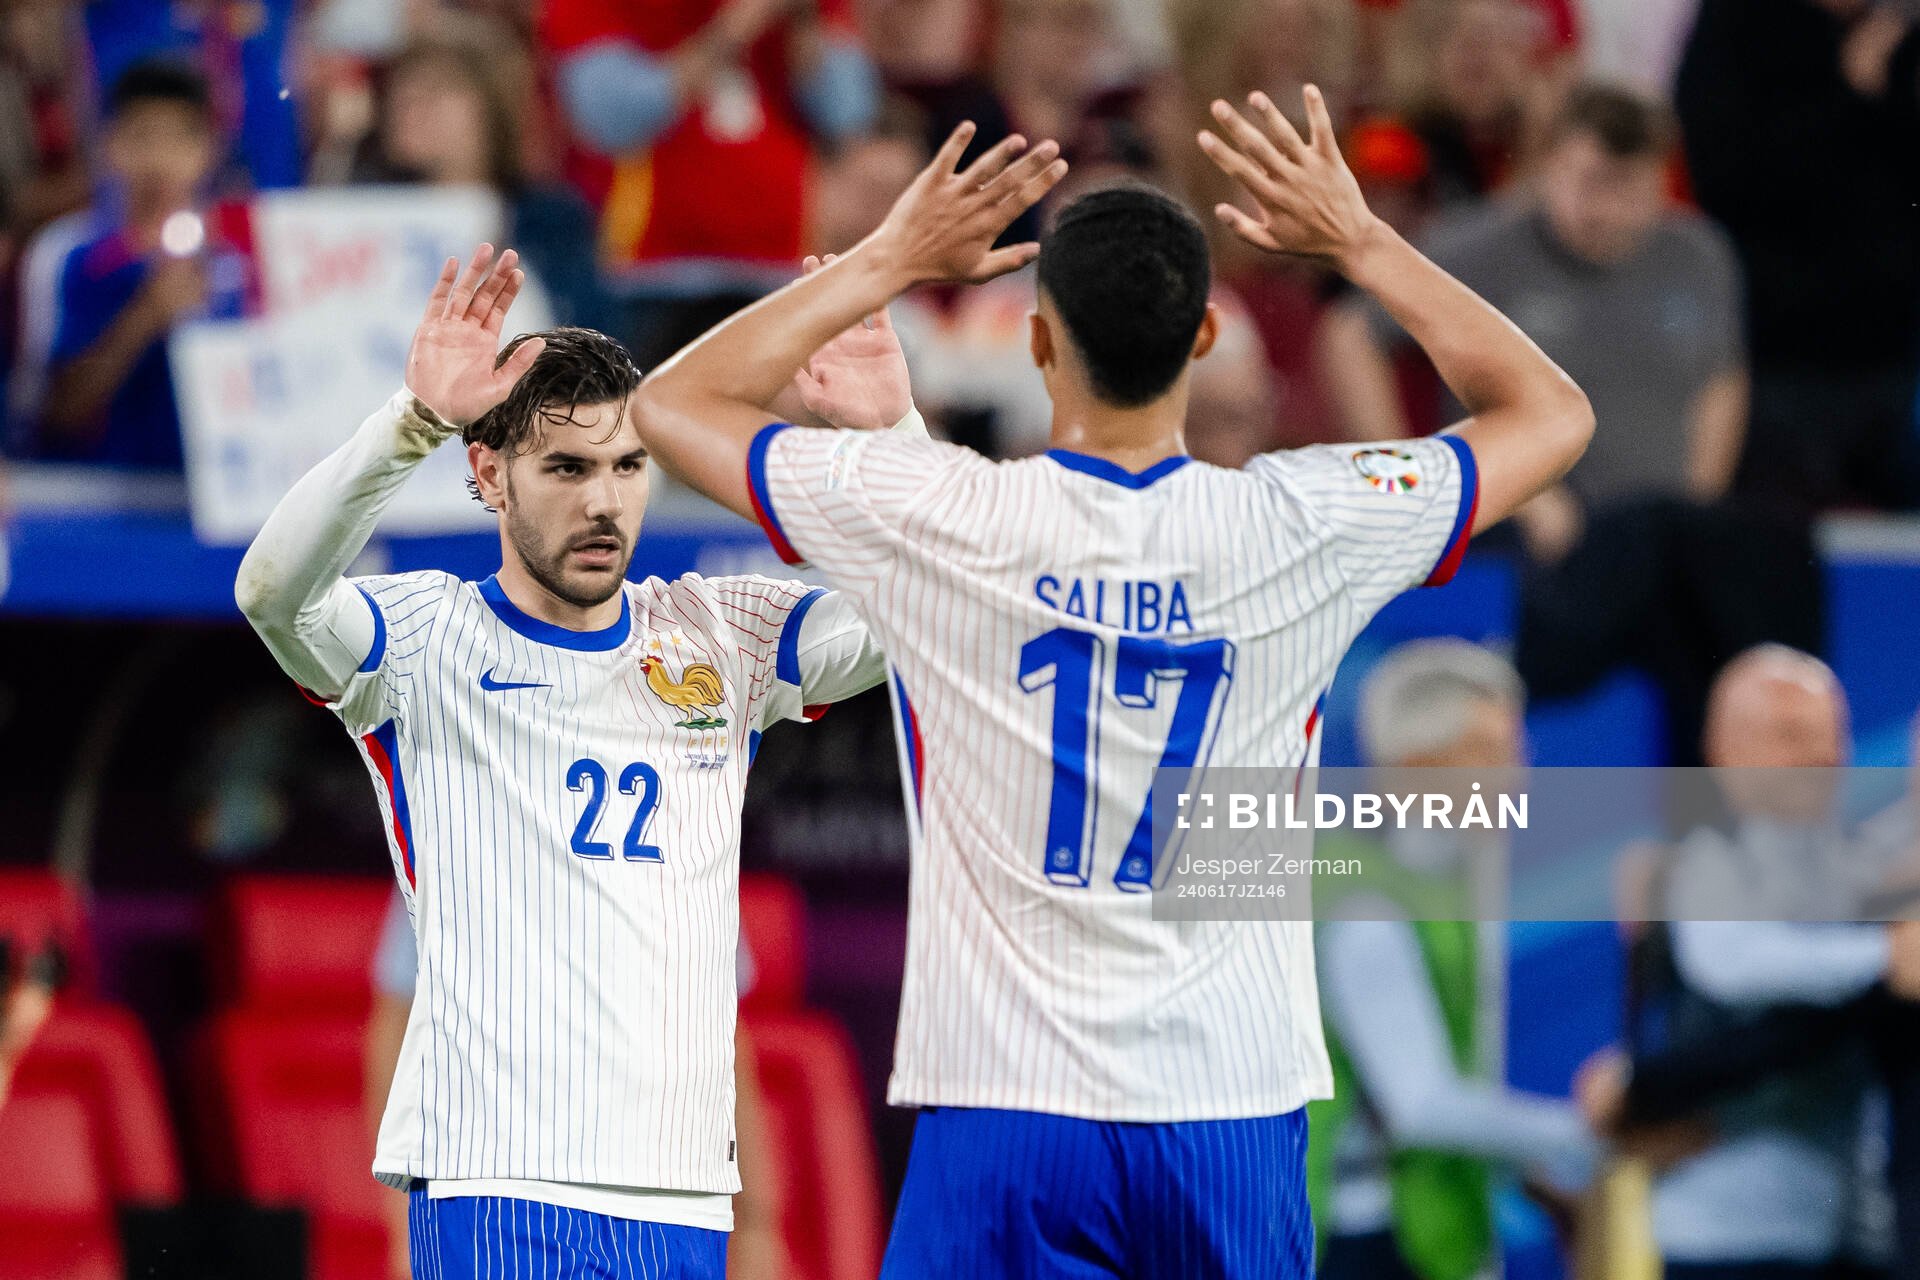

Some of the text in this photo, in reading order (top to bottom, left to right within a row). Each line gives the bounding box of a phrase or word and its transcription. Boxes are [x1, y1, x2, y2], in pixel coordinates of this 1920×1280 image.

[1034, 574, 1194, 633] SALIBA
[566, 758, 665, 864] 22
[1018, 627, 1236, 893] 17
